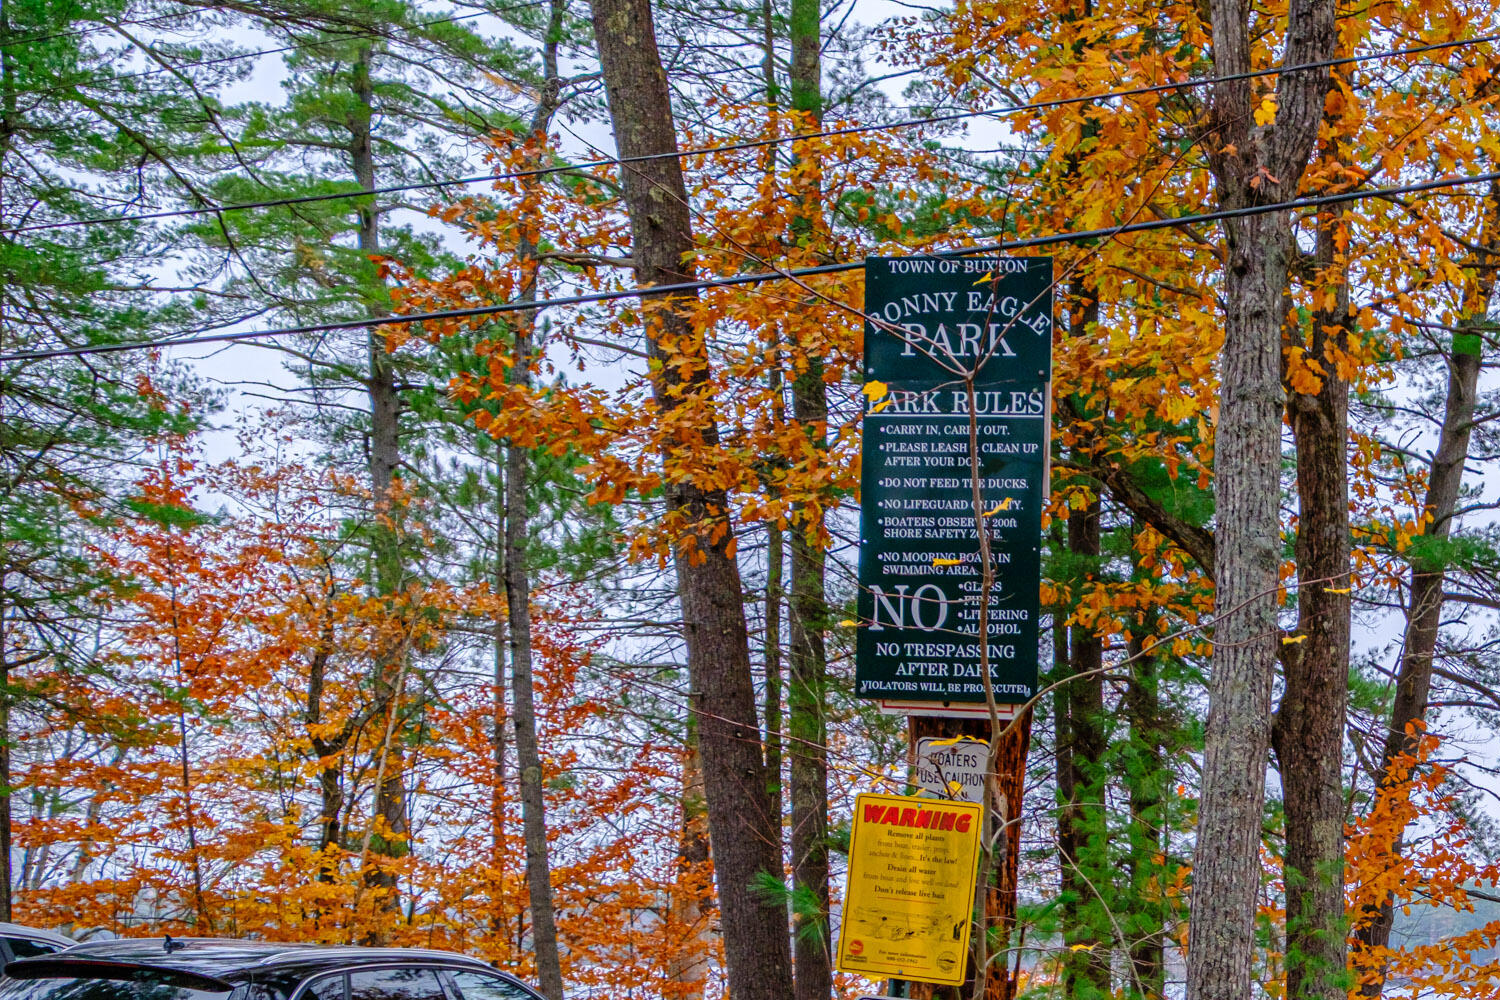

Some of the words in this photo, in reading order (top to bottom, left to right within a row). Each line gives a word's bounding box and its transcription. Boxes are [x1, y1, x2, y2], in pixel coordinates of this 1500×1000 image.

[888, 260, 935, 274] TOWN
[939, 260, 960, 274] OF
[964, 260, 1028, 274] BUXTON
[900, 323, 1017, 357] PARK
[951, 391, 1044, 414] RULES
[885, 424, 923, 436] CARRY
[926, 425, 941, 438] IN,
[984, 425, 1010, 436] OUT.
[885, 442, 928, 453] PLEASE
[931, 443, 967, 454] LEASH
[981, 443, 1020, 454] CLEAN
[1023, 443, 1039, 454] UP
[884, 456, 921, 467] AFTER
[923, 457, 956, 467] YOUR
[885, 478, 900, 488] DO
[903, 478, 928, 488] NOT
[930, 478, 960, 489] FEED
[988, 478, 1029, 490] DUCKS.
[884, 499, 901, 510] NO
[904, 499, 968, 510] LIFEGUARD
[884, 516, 936, 528] BOATERS
[992, 518, 1018, 529] 200ft
[883, 528, 923, 539] SHORE
[925, 529, 967, 539] SAFETY
[883, 552, 900, 562] NO
[959, 552, 996, 563] BOAS
[998, 553, 1011, 563] IN
[882, 565, 944, 575] SWIMMING
[946, 566, 979, 576] AREA.
[868, 583, 948, 632] NO
[963, 623, 1022, 635] ALOHOL
[876, 642, 901, 657] NO
[904, 643, 1015, 659] TRESPASSING
[895, 662, 949, 677] AFTER
[861, 680, 918, 691] VIOLATORS
[920, 682, 946, 692] WILL
[947, 682, 961, 693] BE
[863, 804, 973, 833] WARNING
